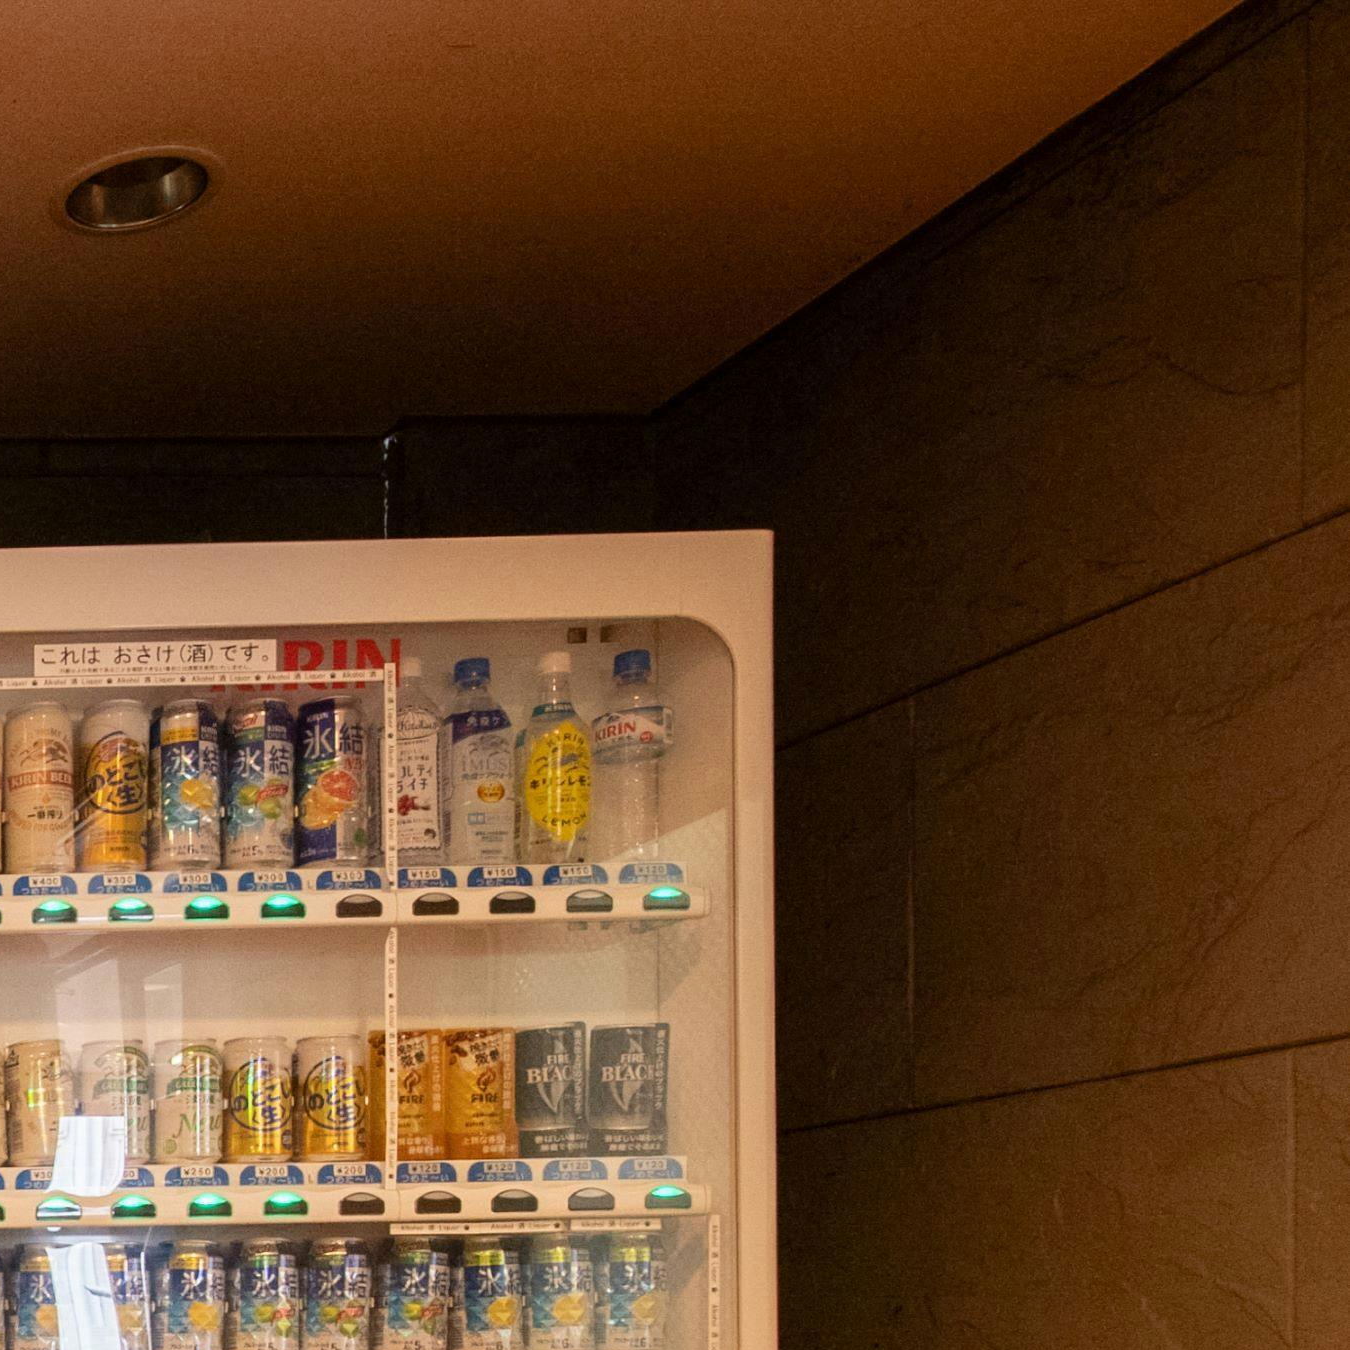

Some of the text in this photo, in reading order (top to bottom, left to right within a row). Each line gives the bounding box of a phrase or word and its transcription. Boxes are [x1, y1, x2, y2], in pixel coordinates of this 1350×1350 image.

[41, 642, 269, 665] これは おさけ（酒）です。
[303, 722, 365, 759] 氷結
[594, 720, 637, 743] KIRIN
[233, 745, 290, 778] 氷結
[541, 813, 588, 827] LEMON
